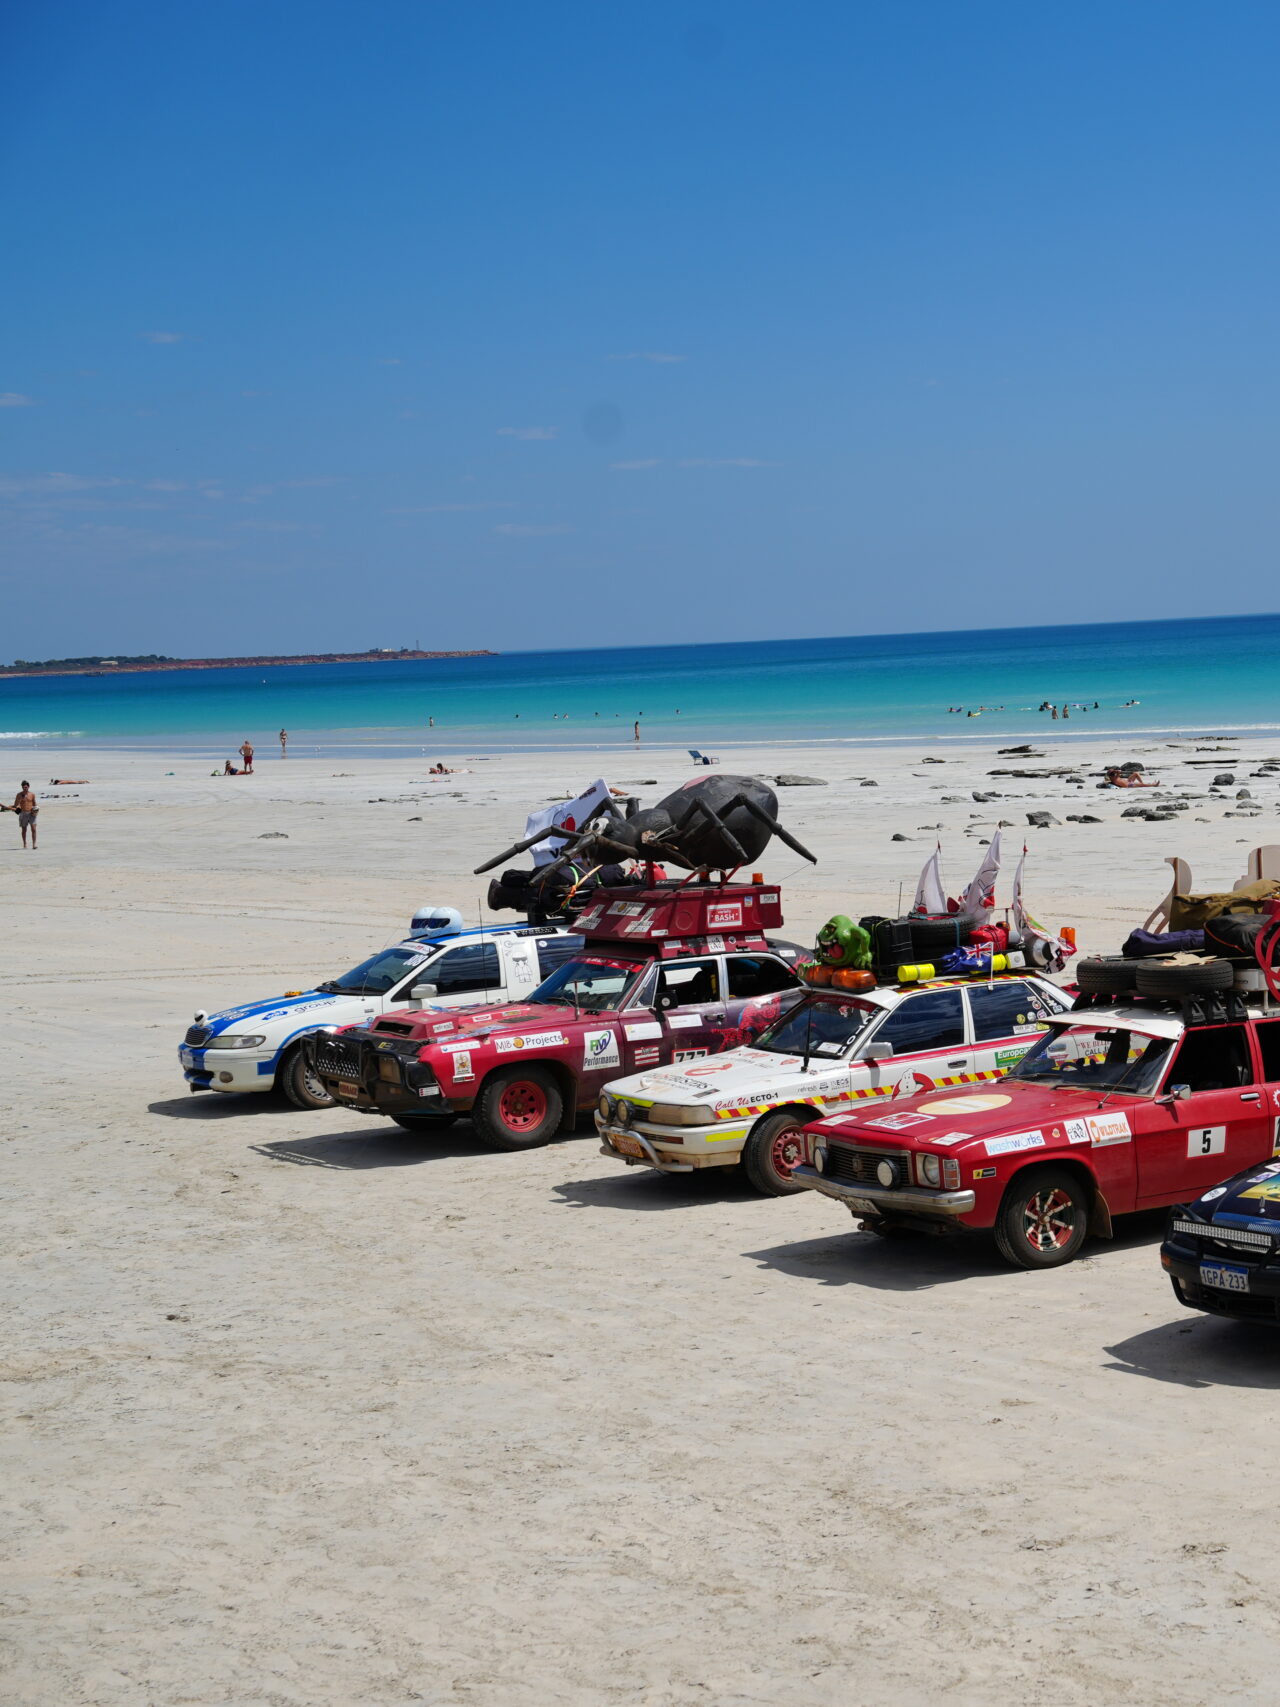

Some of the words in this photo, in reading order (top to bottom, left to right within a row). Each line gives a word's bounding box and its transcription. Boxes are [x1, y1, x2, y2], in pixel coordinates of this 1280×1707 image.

[714, 912, 735, 923] BASH
[525, 1034, 563, 1047] Projects
[584, 1054, 619, 1067] Performance
[675, 1050, 707, 1063] 777
[715, 1099, 736, 1112] Call
[737, 1096, 750, 1108] Us
[750, 1091, 779, 1103] ECTO-1
[1099, 1122, 1128, 1136] WILDTRAK
[1201, 1129, 1212, 1154] 5
